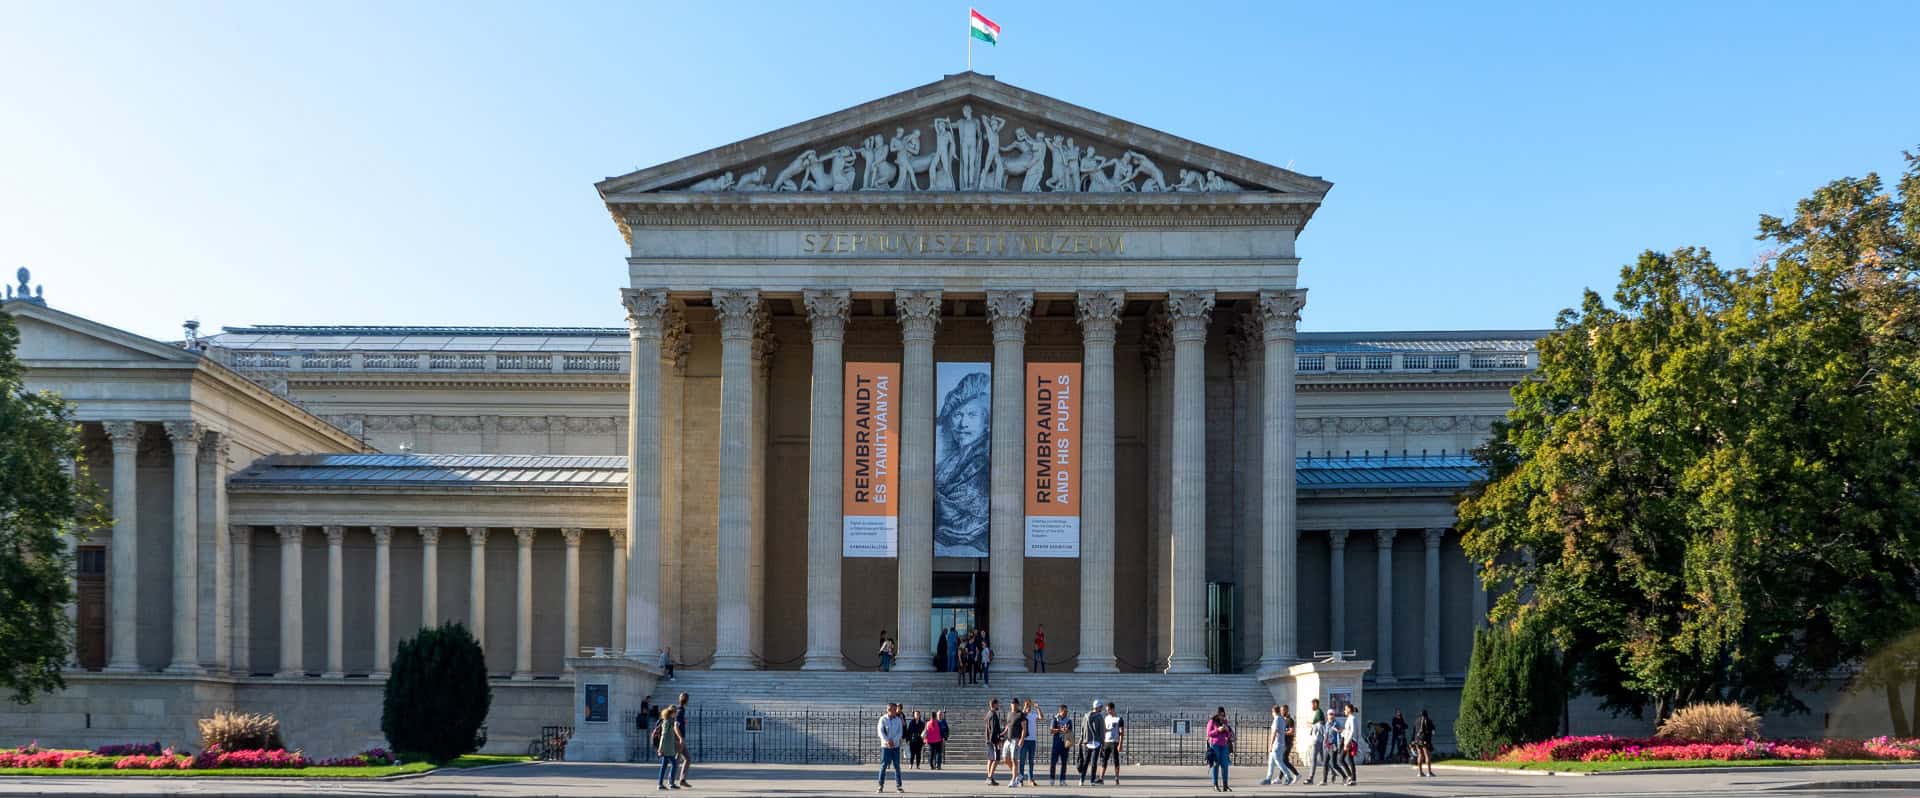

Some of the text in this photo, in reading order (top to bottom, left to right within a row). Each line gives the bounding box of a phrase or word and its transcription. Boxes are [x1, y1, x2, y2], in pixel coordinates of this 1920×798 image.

[855, 374, 871, 503] REMBRANDT
[873, 376, 889, 504] ÉS TANÍTVÁNYAI
[1037, 375, 1052, 504] REMBRANDT
[1057, 375, 1070, 505] AND HIS PUPILS
